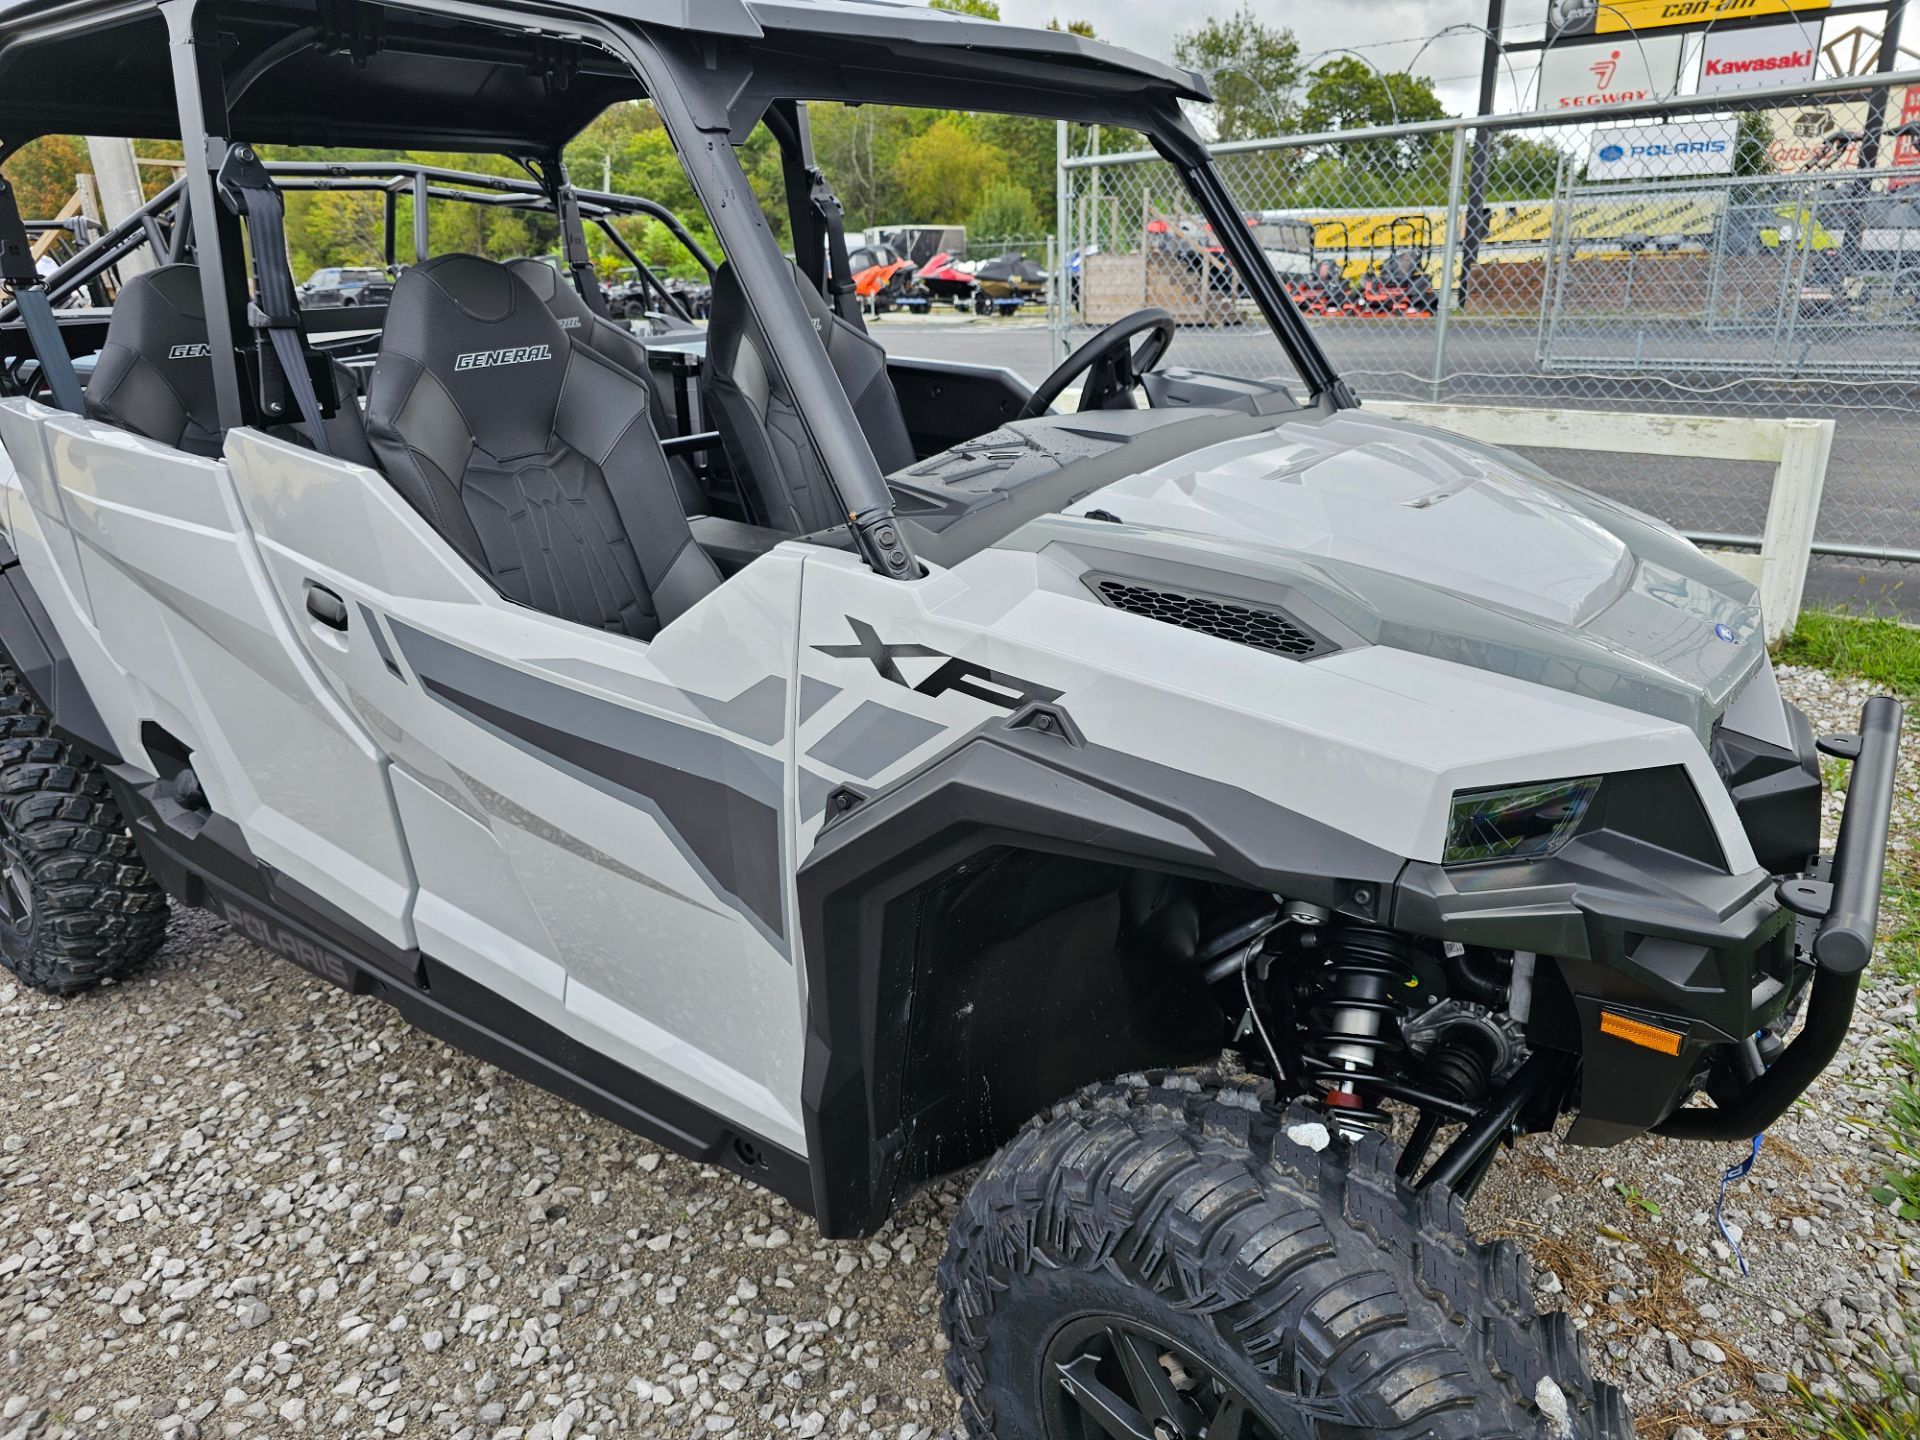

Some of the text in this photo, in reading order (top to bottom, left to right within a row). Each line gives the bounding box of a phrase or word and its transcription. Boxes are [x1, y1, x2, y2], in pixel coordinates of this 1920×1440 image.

[1705, 50, 1812, 76] Kawasaki
[1558, 90, 1650, 109] SEGWAY
[1630, 140, 1726, 157] POLARIS
[455, 345, 552, 371] GENERAL
[808, 614, 1067, 711] XP
[221, 900, 349, 984] POLARIS
